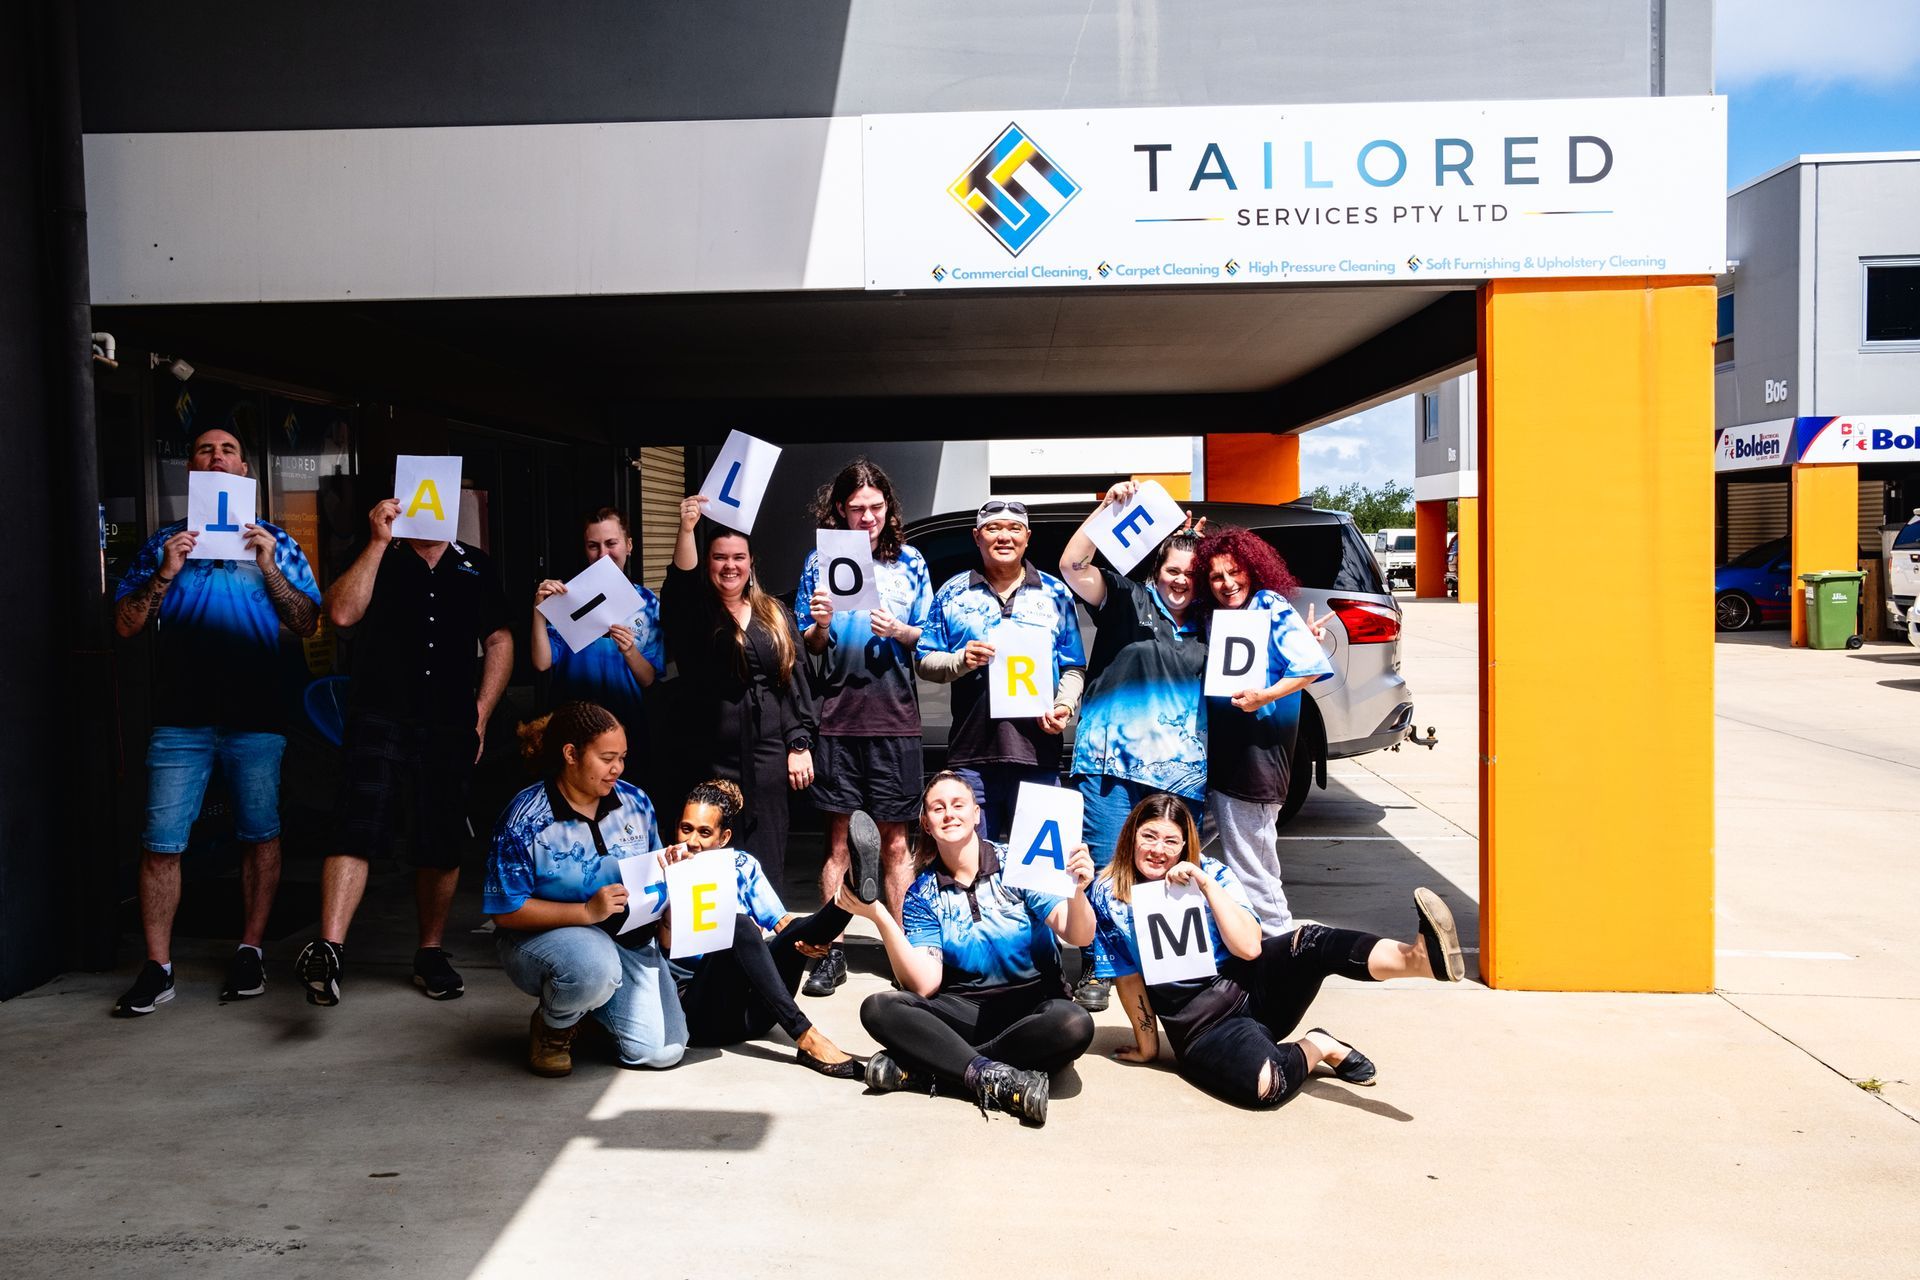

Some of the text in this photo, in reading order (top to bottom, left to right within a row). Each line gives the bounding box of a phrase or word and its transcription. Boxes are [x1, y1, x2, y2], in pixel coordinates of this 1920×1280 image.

[1133, 135, 1614, 192] TAILORED
[1237, 204, 1508, 226] SERVICES PTY LTD
[951, 265, 1089, 281] Commercial Cleaning
[1115, 262, 1220, 279] Carpet Cleaning
[1248, 260, 1396, 276] High Pressure Cleaning
[1426, 255, 1667, 272] Soft Furnishing & Upholstery Cleaning
[1765, 379, 1788, 403] B06
[1735, 434, 1780, 459] Bolden
[406, 479, 445, 521] A
[718, 461, 742, 508] L
[205, 491, 240, 532] T
[1111, 504, 1155, 549] E
[828, 557, 864, 597] O
[1007, 655, 1038, 697] R
[1222, 636, 1256, 677] D
[1022, 819, 1066, 871] A
[692, 883, 718, 932] E
[1147, 906, 1209, 960] M
